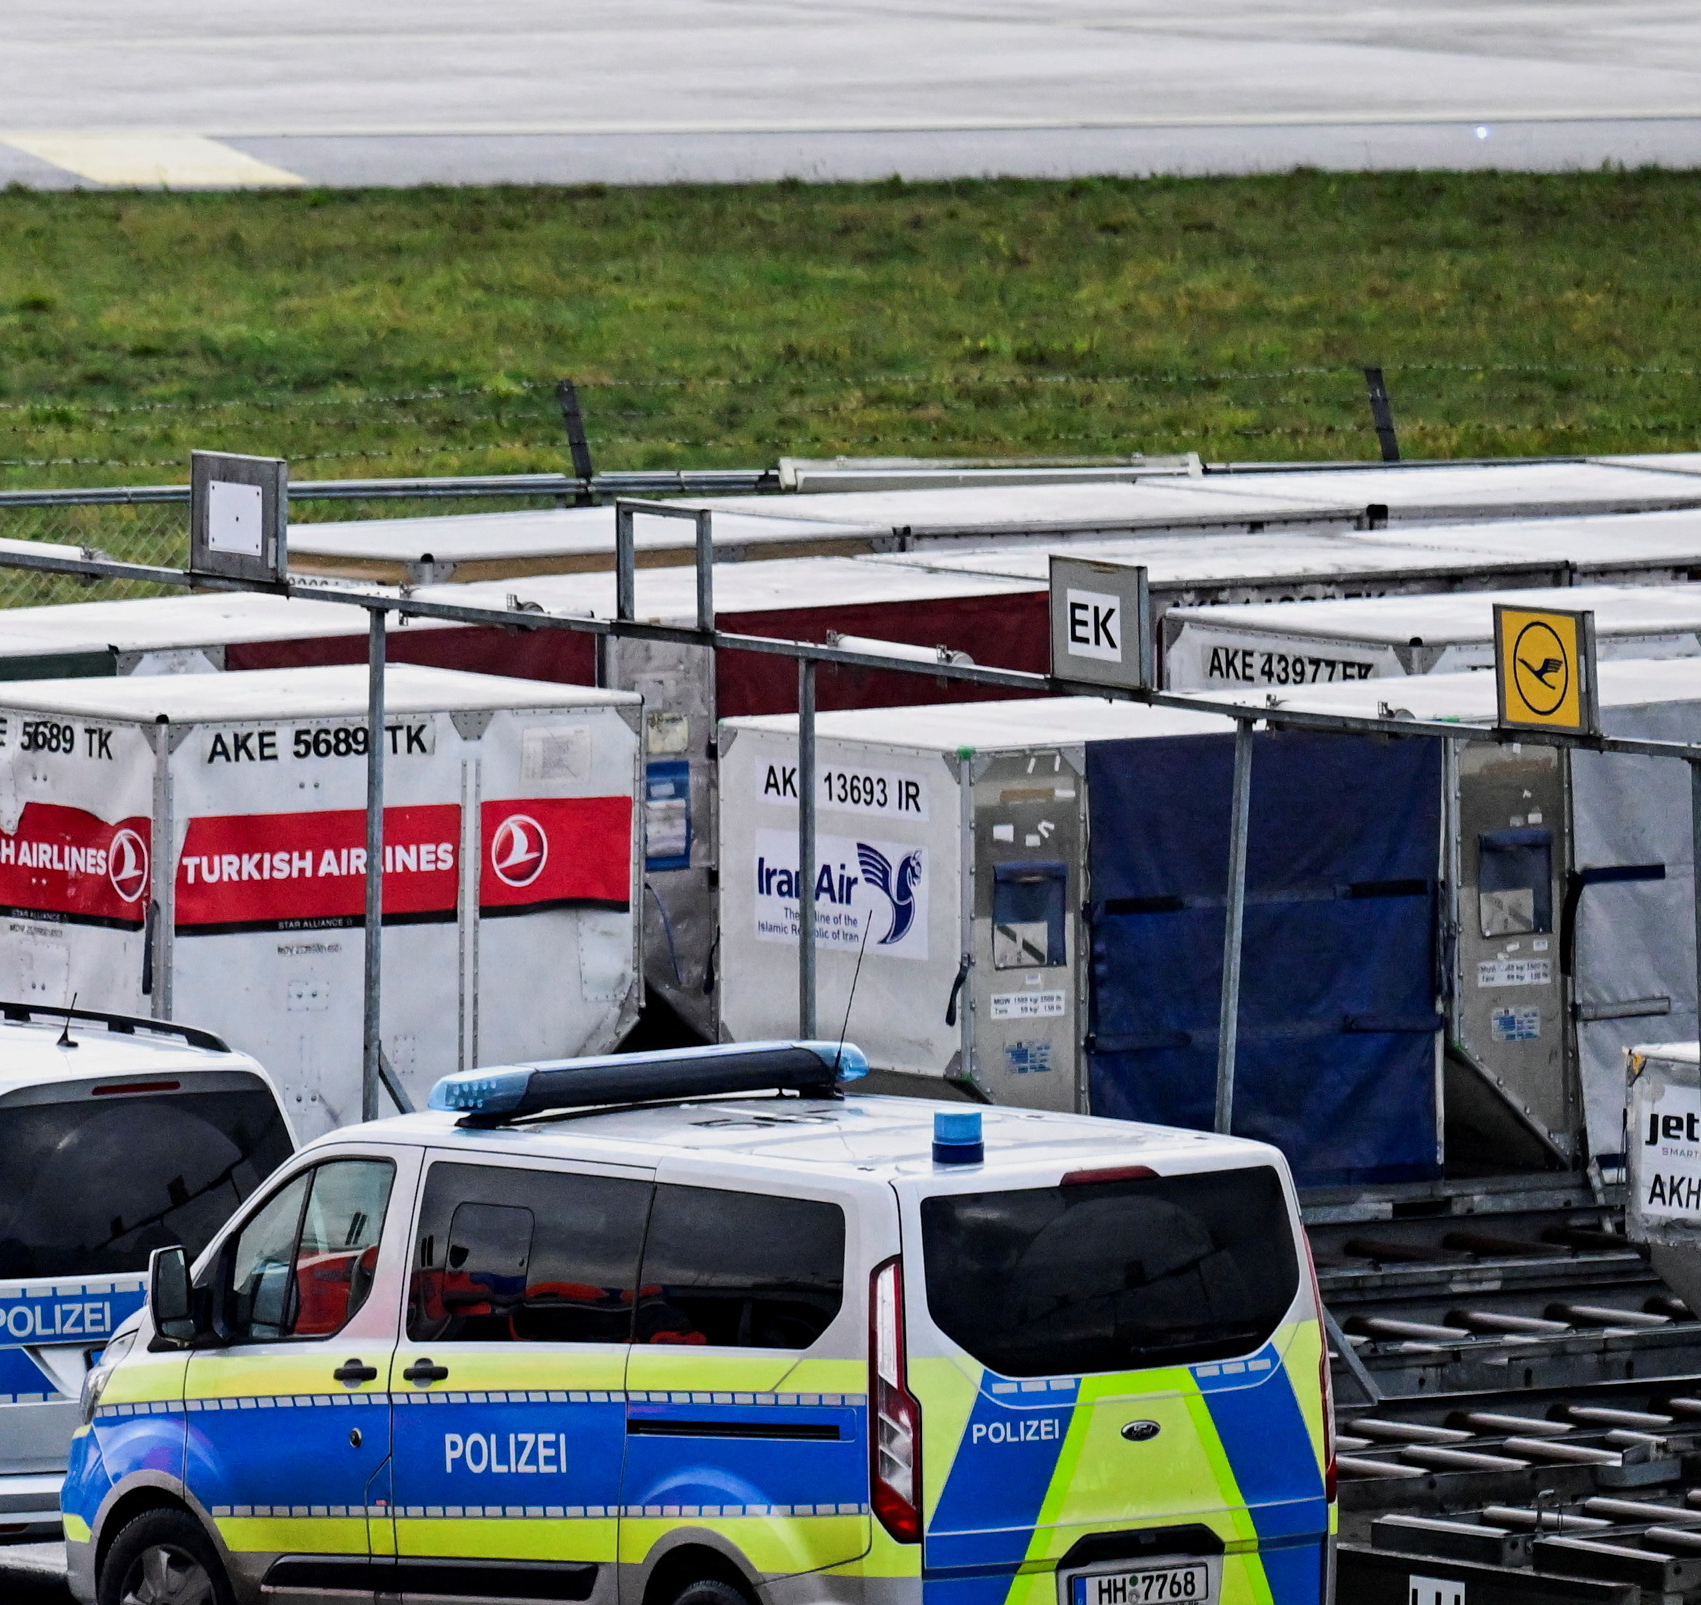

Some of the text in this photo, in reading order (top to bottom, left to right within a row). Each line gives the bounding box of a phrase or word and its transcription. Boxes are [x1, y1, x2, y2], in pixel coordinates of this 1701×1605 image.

[1070, 602, 1117, 649] EK
[1209, 647, 1255, 682] AKE
[1260, 652, 1337, 684] 43977
[20, 720, 74, 754] 5689
[84, 728, 113, 760] TK
[207, 724, 427, 764] AKE 5689 TK
[764, 765, 921, 813] AK 13693 IR
[17, 841, 108, 876] AIRLINES
[182, 843, 453, 884] TURKISH AIRINES
[278, 919, 343, 930] STAR ALLIANCE
[758, 920, 789, 935] Islamic
[1662, 1147, 1699, 1158] SMART
[1648, 1173, 1700, 1210] AKH
[972, 1418, 1060, 1444] POLIZEI
[444, 1433, 567, 1473] POLIZEI
[1098, 1577, 1127, 1605] HH
[1141, 1571, 1196, 1600] 7768
